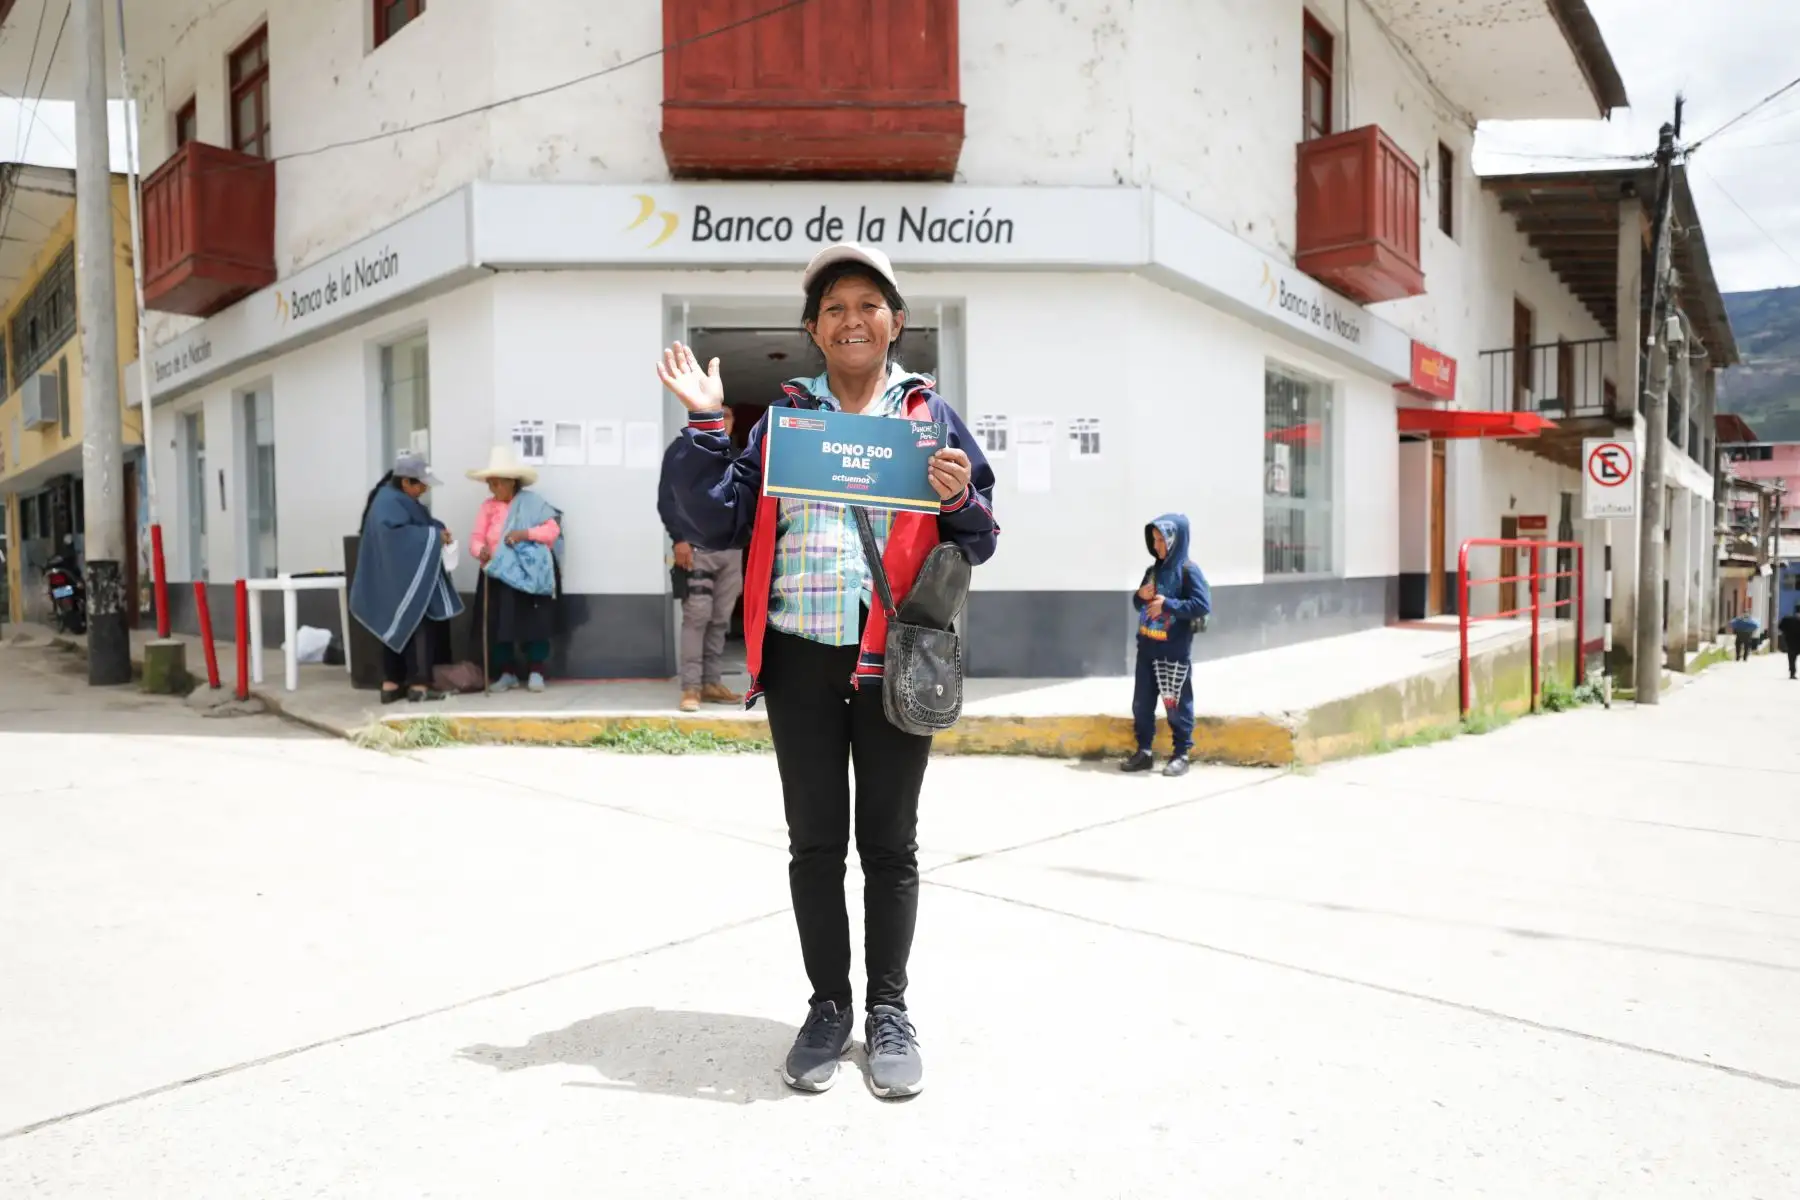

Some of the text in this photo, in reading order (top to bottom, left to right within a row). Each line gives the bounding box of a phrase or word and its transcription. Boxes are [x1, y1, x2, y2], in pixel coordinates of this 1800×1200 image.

[691, 204, 1015, 244] Banco de la Nación
[291, 245, 398, 320] Banco de la Nación
[1279, 278, 1361, 343] Banco de la Nación
[822, 441, 893, 459] BONO 500
[842, 456, 870, 470] BAE
[1601, 451, 1618, 477] E
[831, 474, 870, 484] actuemos
